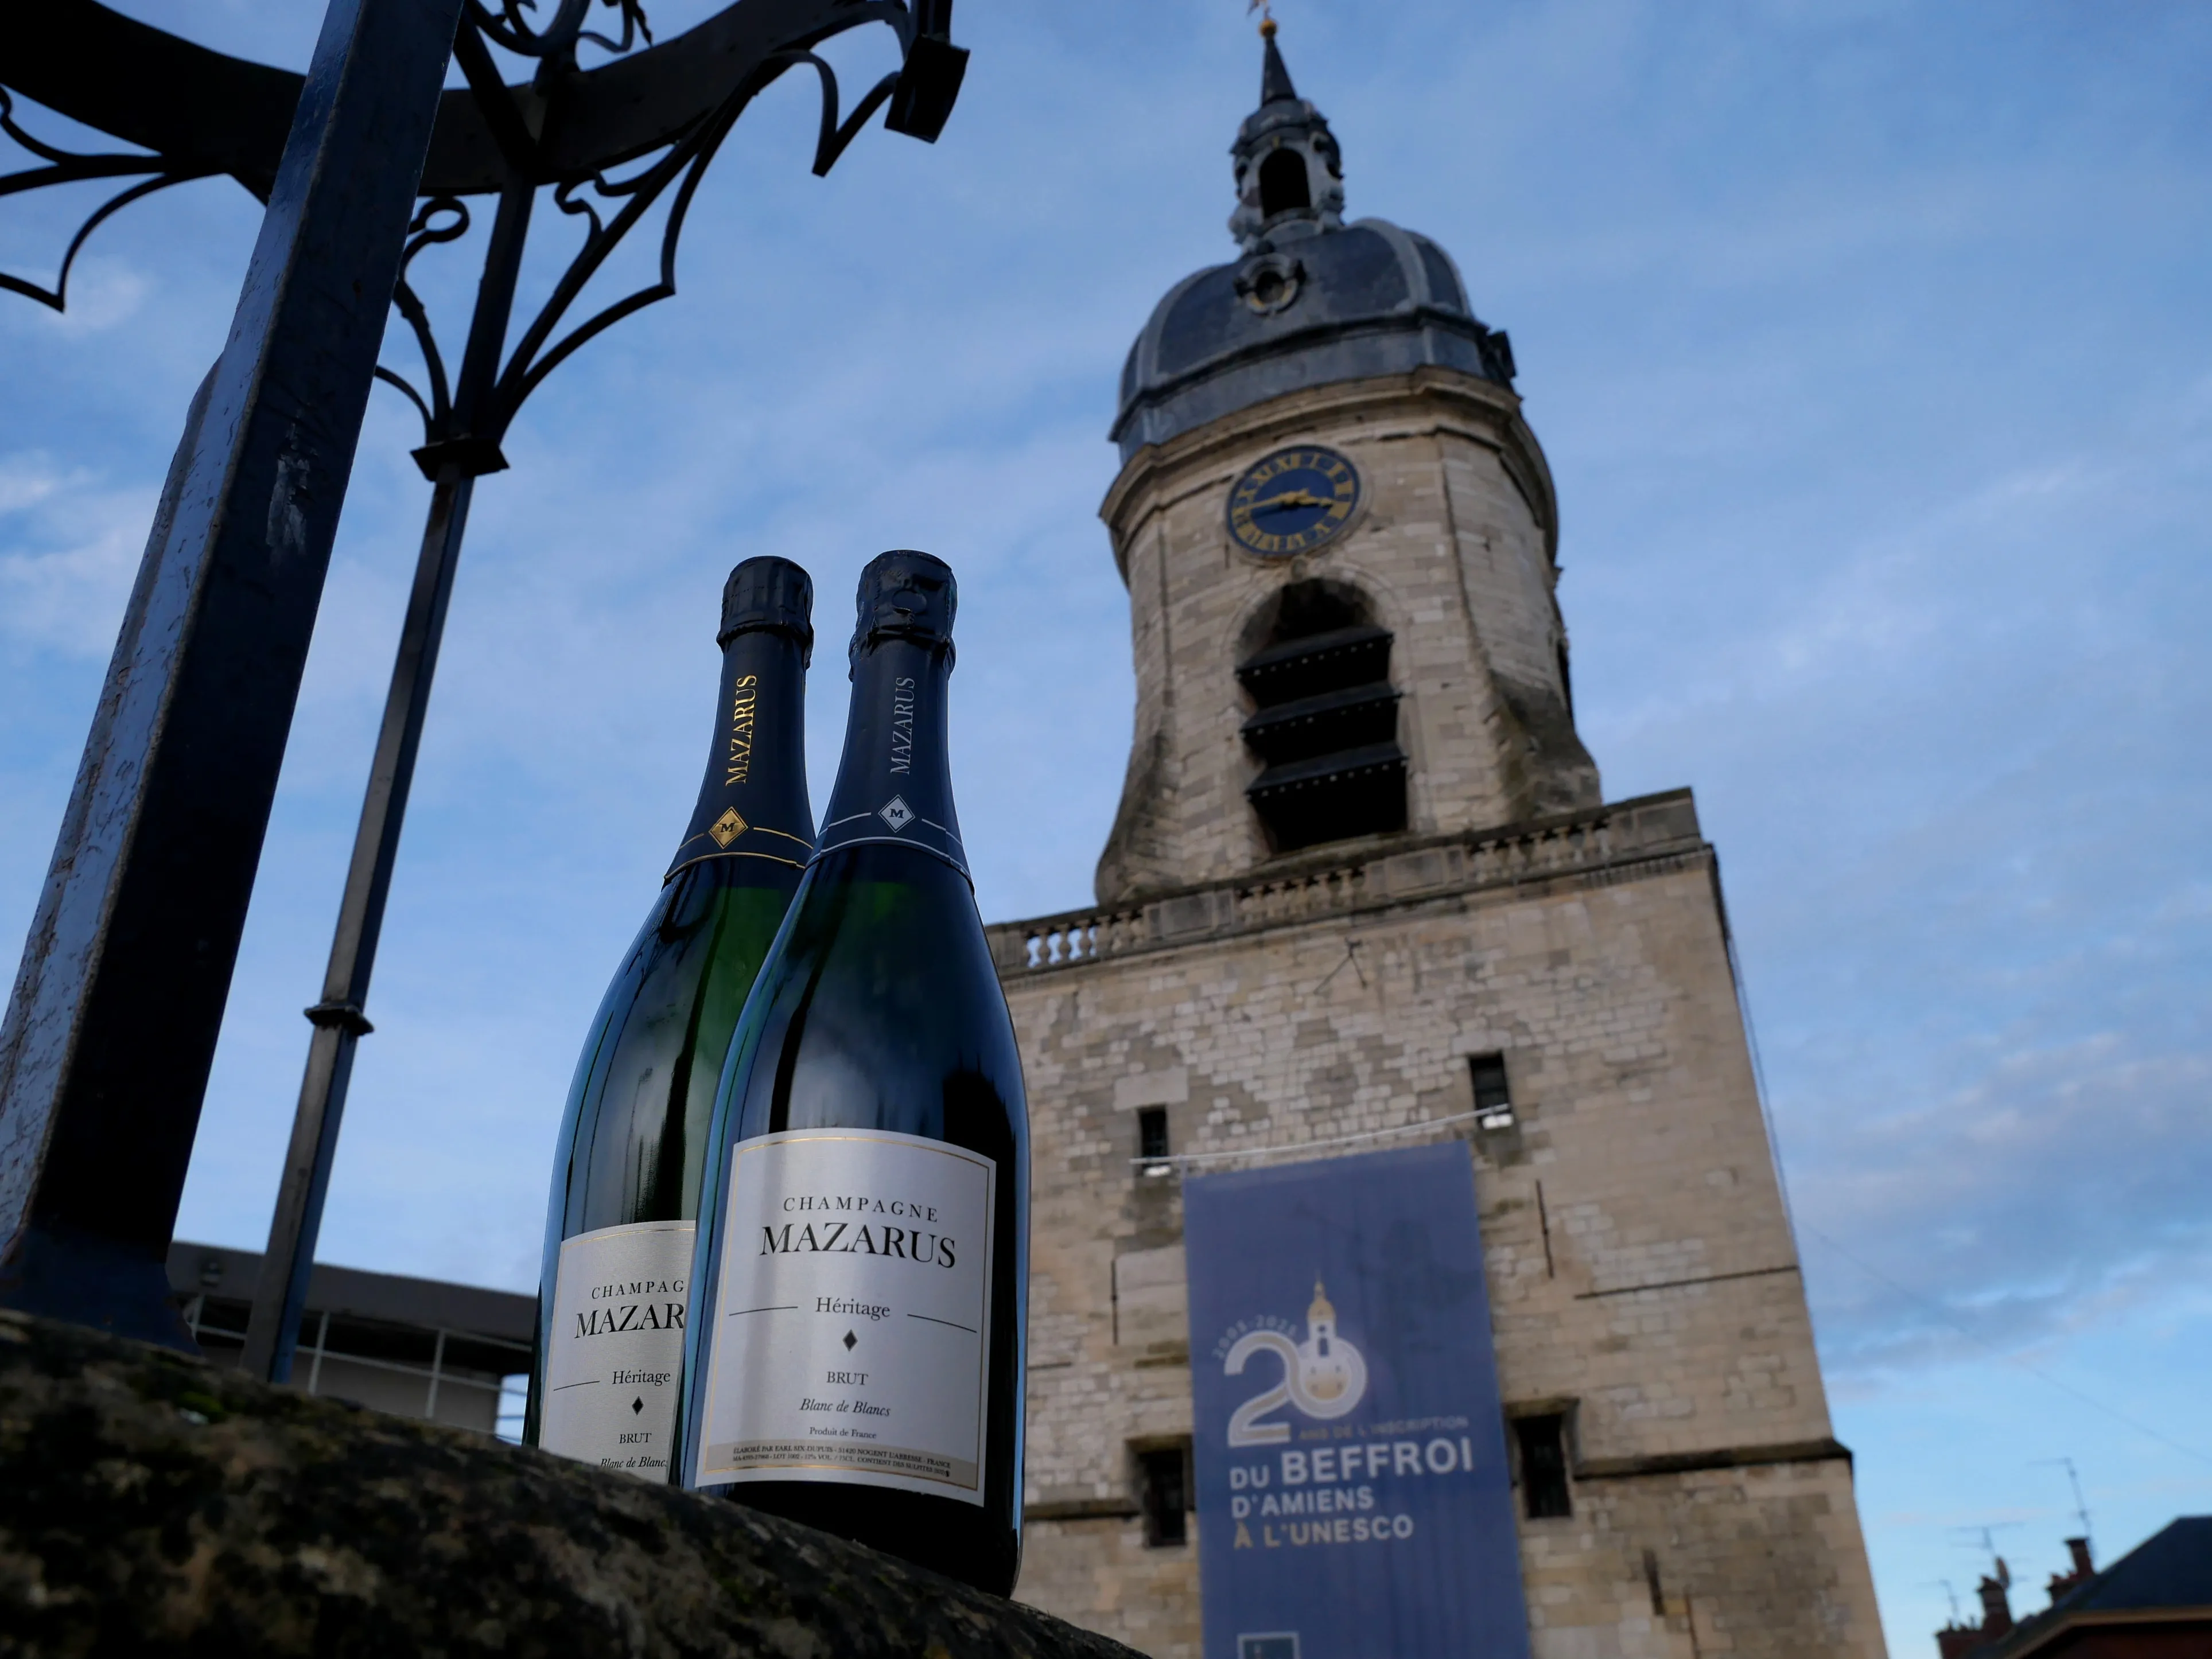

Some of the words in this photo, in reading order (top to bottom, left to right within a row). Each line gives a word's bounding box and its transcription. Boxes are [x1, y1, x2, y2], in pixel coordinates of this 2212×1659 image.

[725, 674, 757, 786] MAZARUS
[890, 676, 915, 775] MAZARUS
[889, 808, 905, 819] M
[720, 822, 736, 833] M
[783, 1196, 938, 1222] CHAMPAGNE
[759, 1222, 956, 1268] MAZARUS
[815, 1297, 891, 1321] Héritage
[574, 1303, 685, 1339] MAZAR
[612, 1369, 671, 1387] Héritage
[826, 1371, 869, 1385] BRUT
[799, 1397, 834, 1412] Blanc
[836, 1400, 849, 1412] de
[852, 1400, 891, 1417] Blancs
[619, 1432, 652, 1444] BRUT
[809, 1426, 838, 1436] Produit
[839, 1428, 849, 1436] de
[851, 1428, 877, 1439] France
[601, 1458, 624, 1469] Blanc
[626, 1457, 636, 1468] de
[857, 1448, 888, 1458] NOGENT
[927, 1458, 951, 1469] FRANCE
[857, 1457, 891, 1466] CONTIENT
[1229, 1465, 1269, 1490] DU
[1281, 1436, 1474, 1486] BEFFROI
[1231, 1485, 1375, 1519] D'AMIENS
[1233, 1517, 1253, 1549] À
[1264, 1514, 1414, 1548] L'UNESCO
